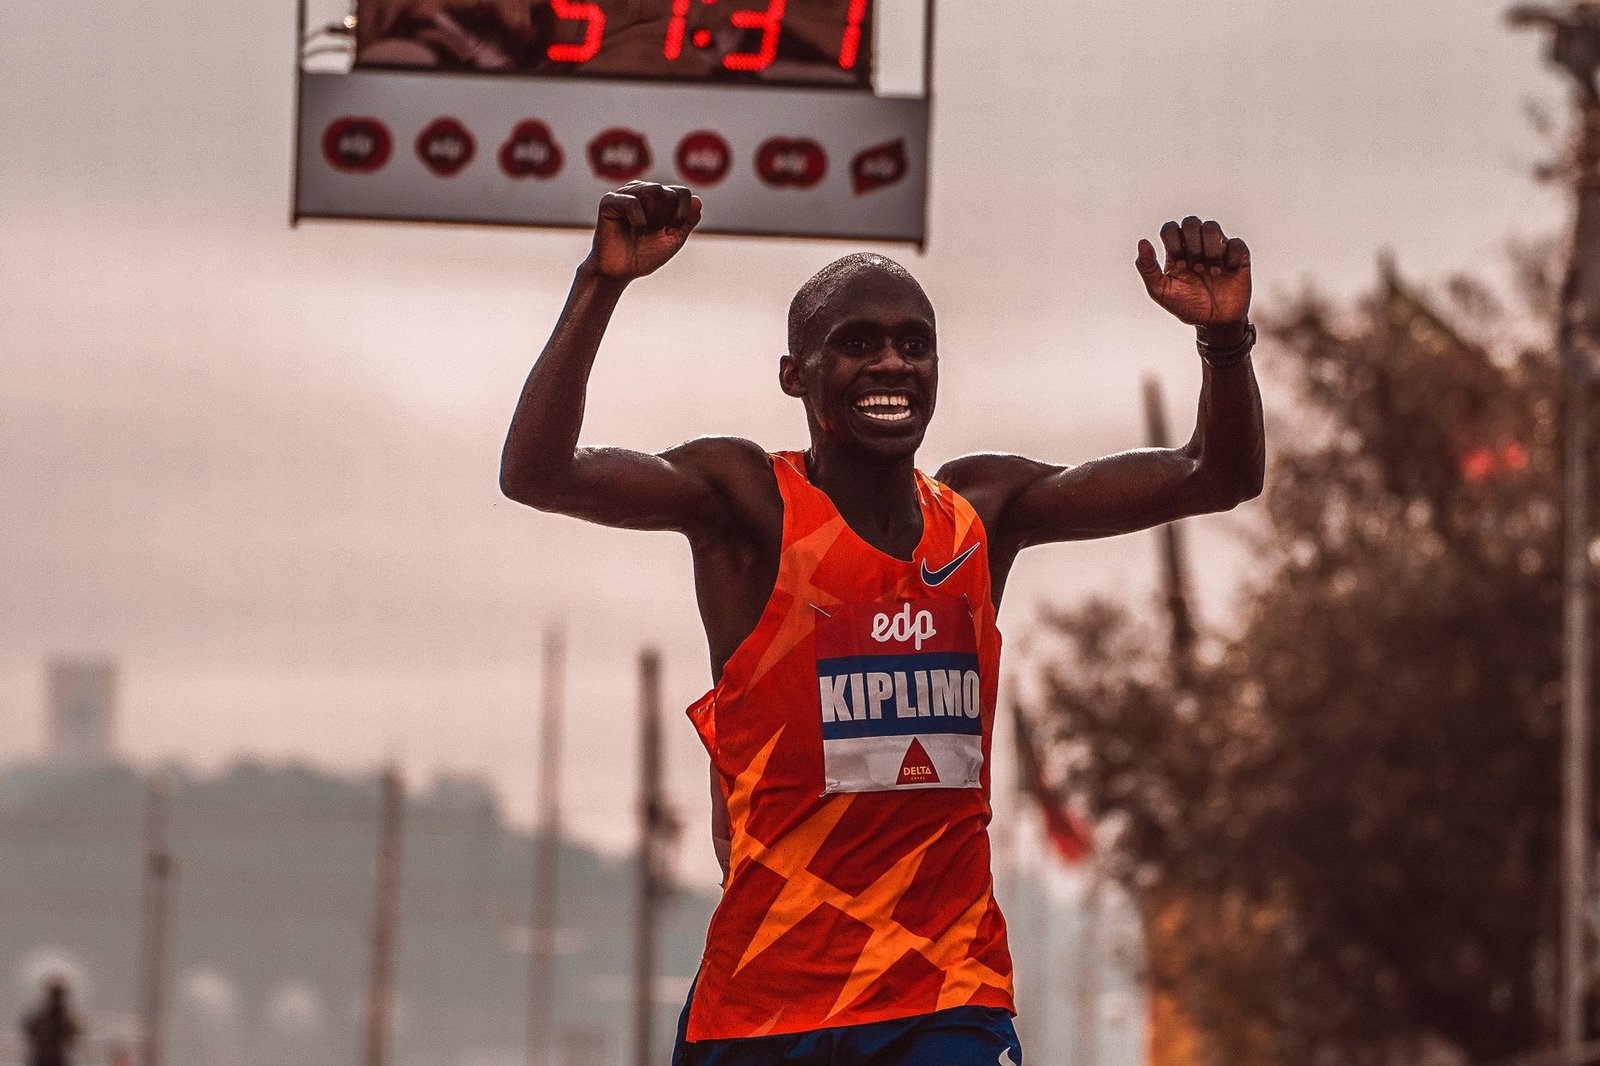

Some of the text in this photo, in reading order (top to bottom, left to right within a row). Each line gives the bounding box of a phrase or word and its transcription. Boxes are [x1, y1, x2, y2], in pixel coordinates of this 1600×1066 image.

[871, 602, 937, 651] edp
[819, 669, 981, 723] KIPLIMO
[903, 766, 932, 776] DELTA
